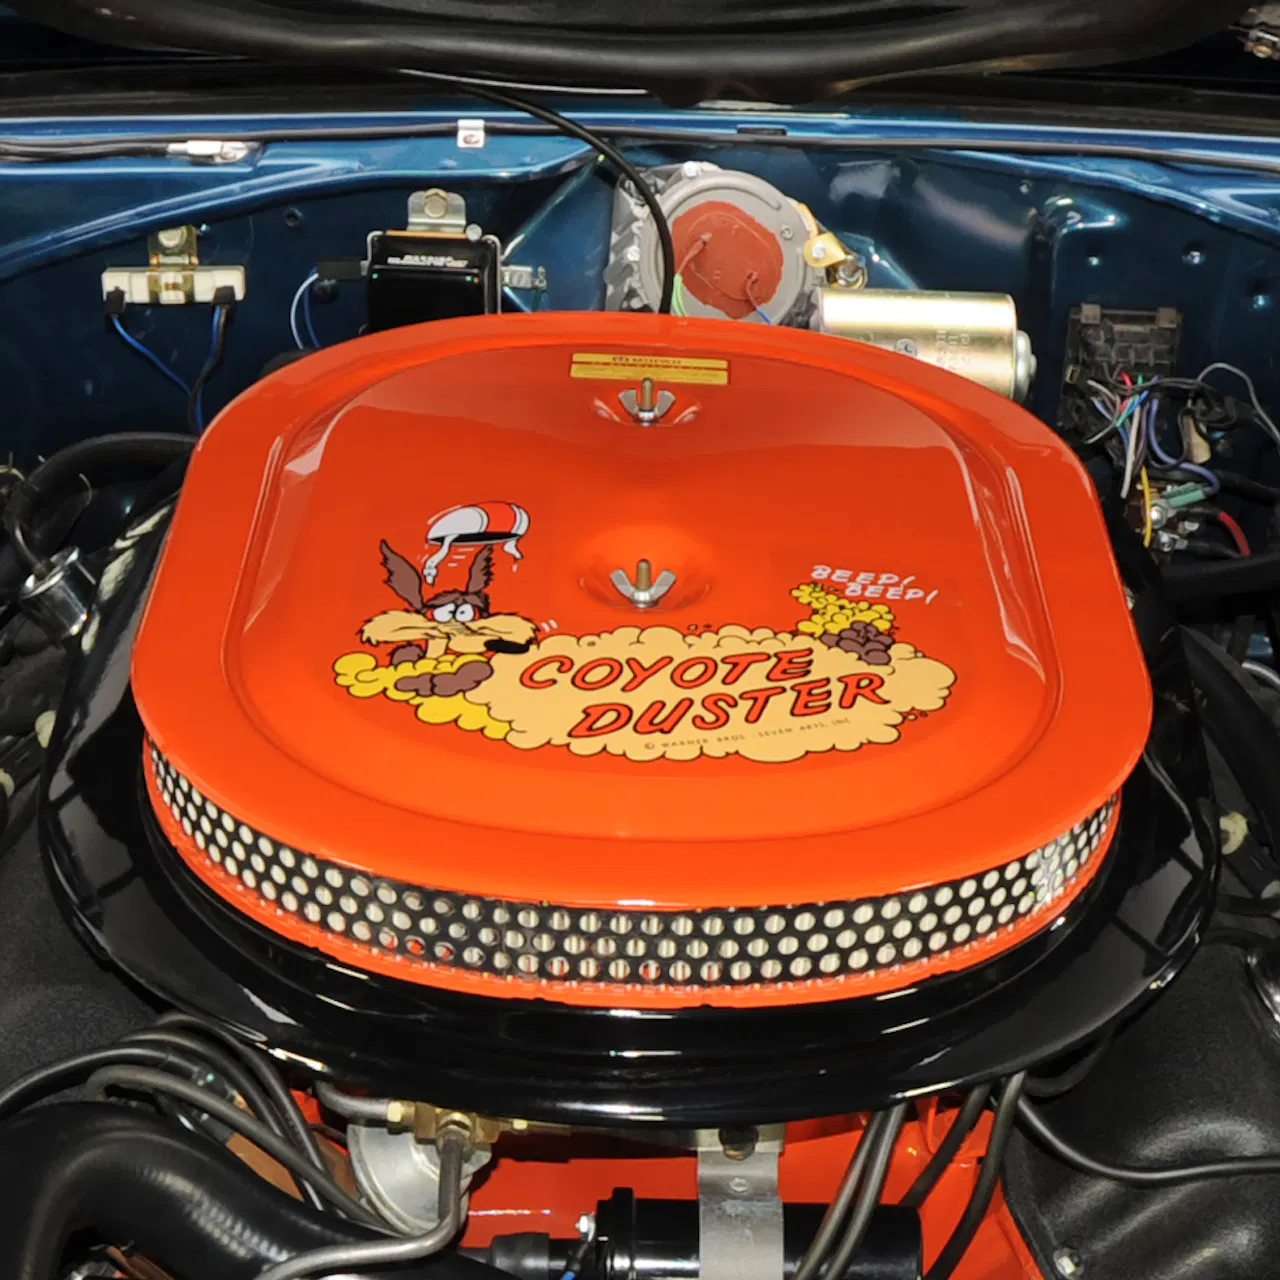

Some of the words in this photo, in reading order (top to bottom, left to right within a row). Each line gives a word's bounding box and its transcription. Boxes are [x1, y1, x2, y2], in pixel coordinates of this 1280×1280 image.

[810, 564, 917, 588] BEEP!
[844, 580, 940, 605] BEEP!
[519, 646, 815, 692] COYOTE
[568, 671, 892, 739] DUSTER
